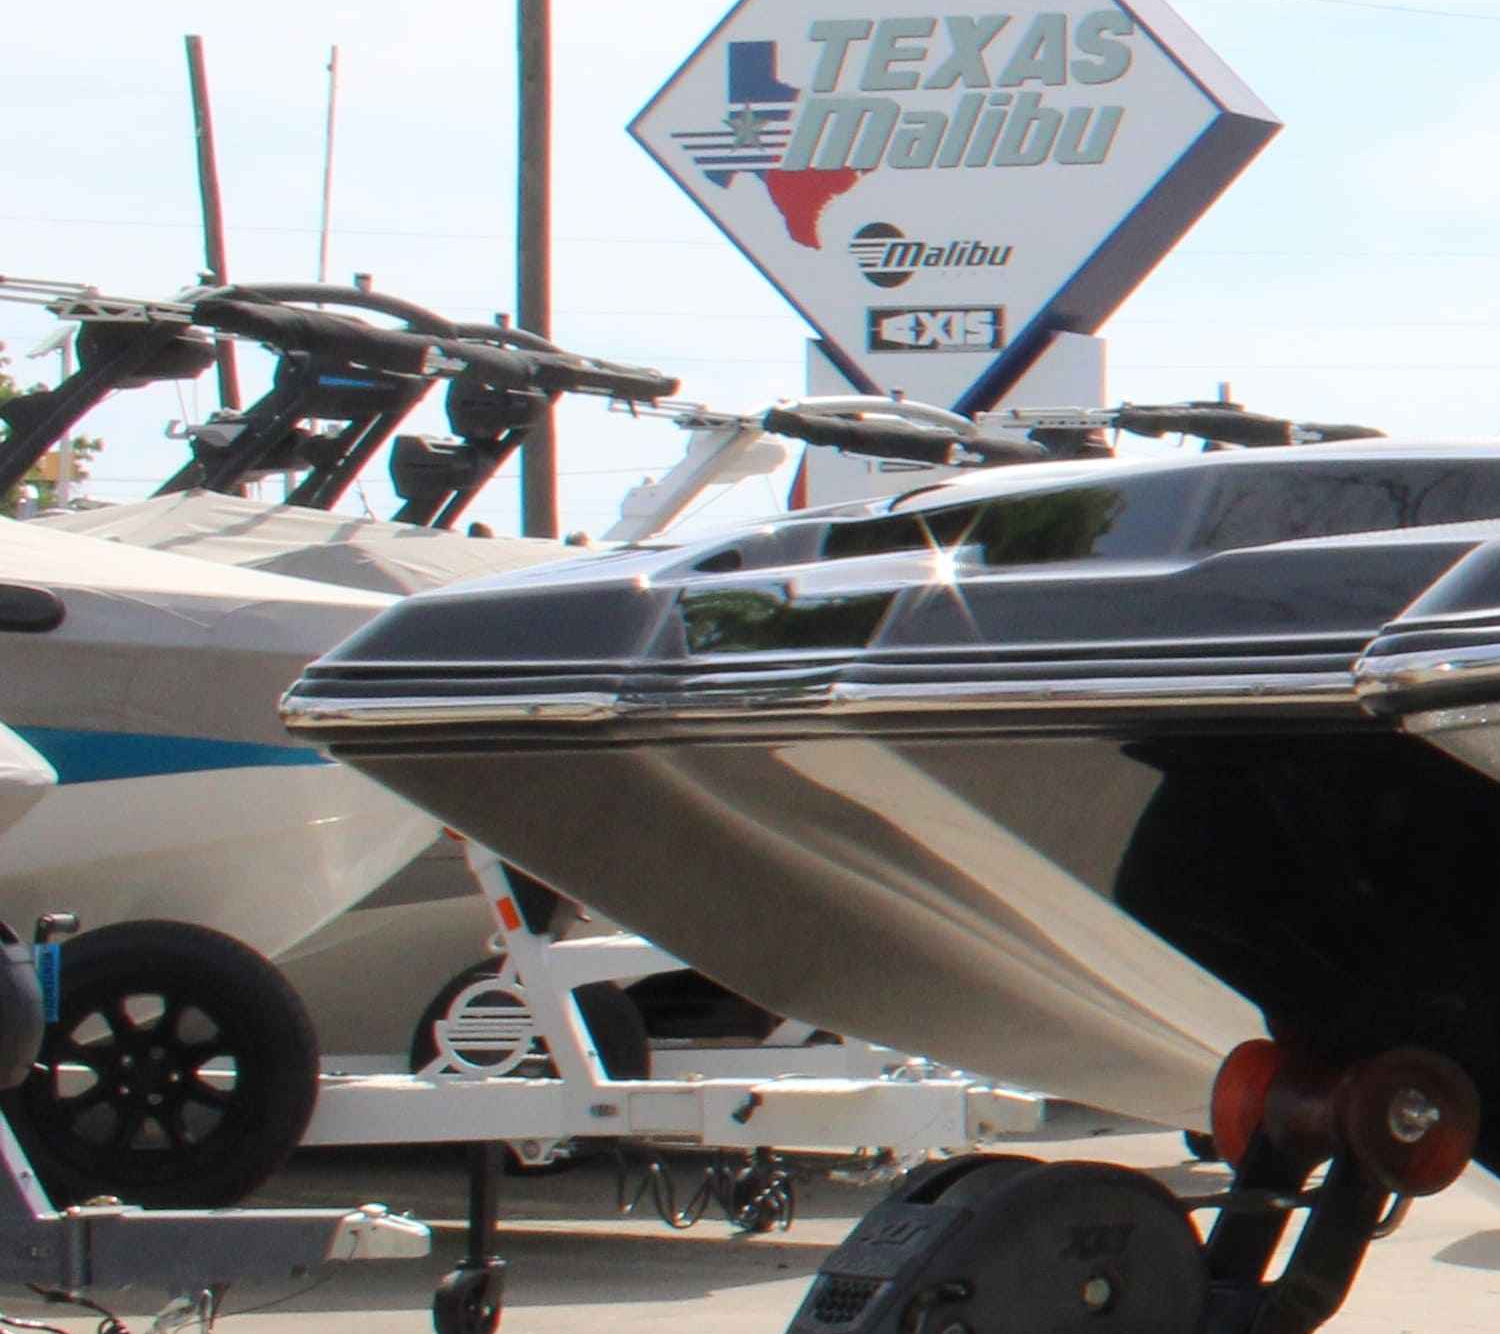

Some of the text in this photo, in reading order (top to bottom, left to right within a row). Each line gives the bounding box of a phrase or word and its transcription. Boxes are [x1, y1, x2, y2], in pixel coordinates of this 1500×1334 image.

[808, 10, 1135, 94] TEXAS
[779, 91, 1126, 173] Malibu
[879, 240, 1013, 268] Malibu
